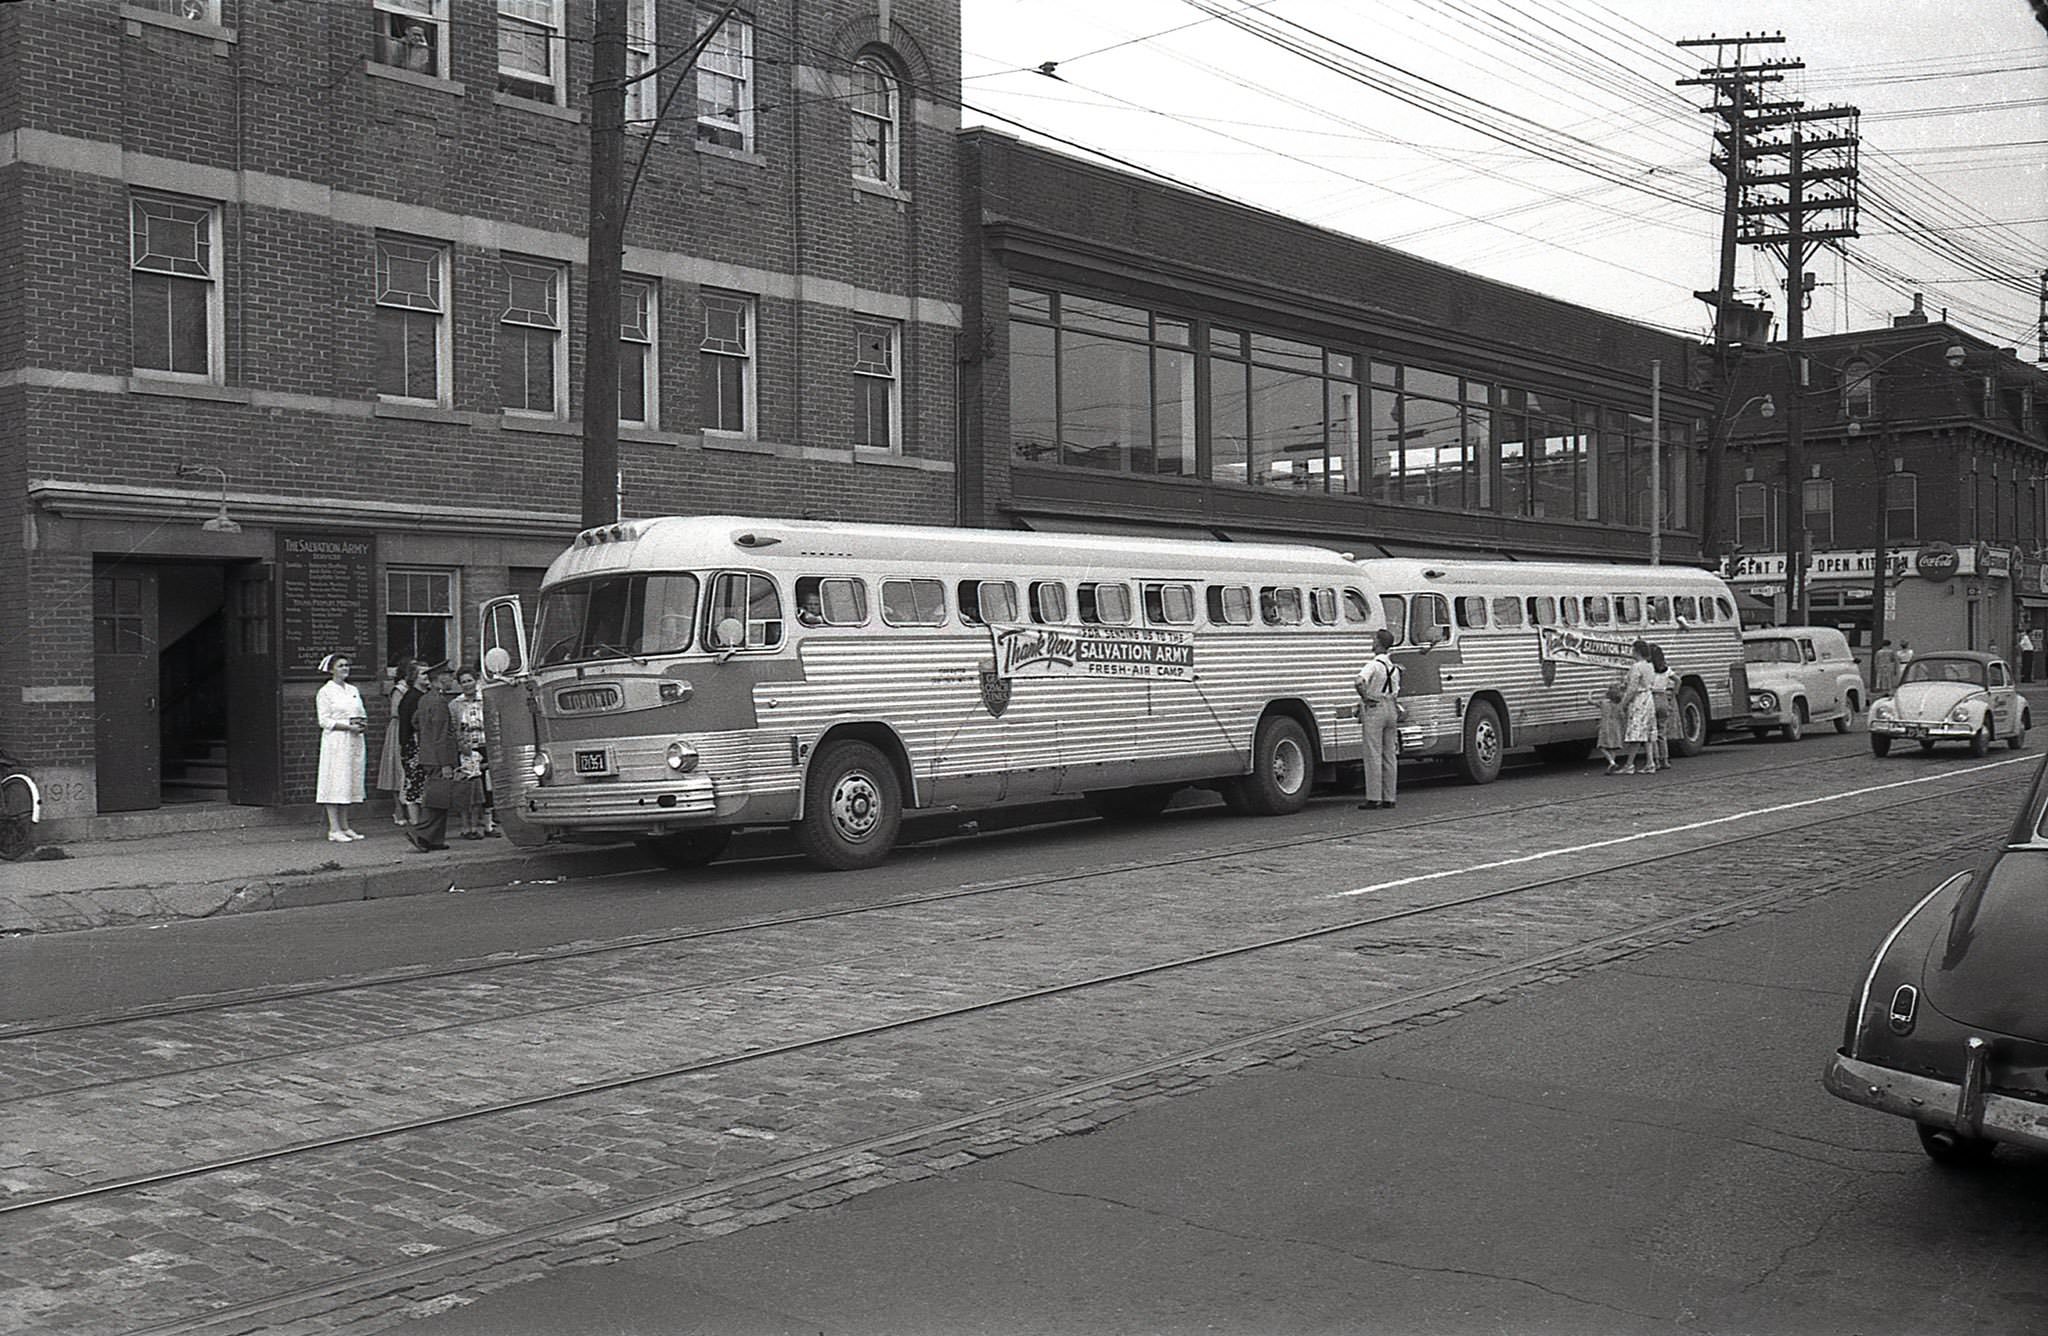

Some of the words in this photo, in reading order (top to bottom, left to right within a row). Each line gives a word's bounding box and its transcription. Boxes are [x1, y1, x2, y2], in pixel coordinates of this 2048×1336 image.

[298, 539, 341, 553] SALVATION
[341, 541, 369, 555] ARMY
[1818, 558, 1850, 572] OPEN
[1081, 628, 1101, 639] FOR
[1104, 629, 1140, 640] SENDING
[1156, 631, 1167, 642] TO
[1168, 632, 1184, 643] THE
[997, 628, 1045, 673] Thank
[1047, 631, 1077, 669] You
[1080, 642, 1151, 661] SALVATION
[1155, 645, 1190, 663] ARMY
[1088, 663, 1151, 676] FRESH-AIR
[1156, 666, 1184, 677] CAMP
[566, 691, 616, 710] TORONTO
[44, 783, 85, 802] 1912
